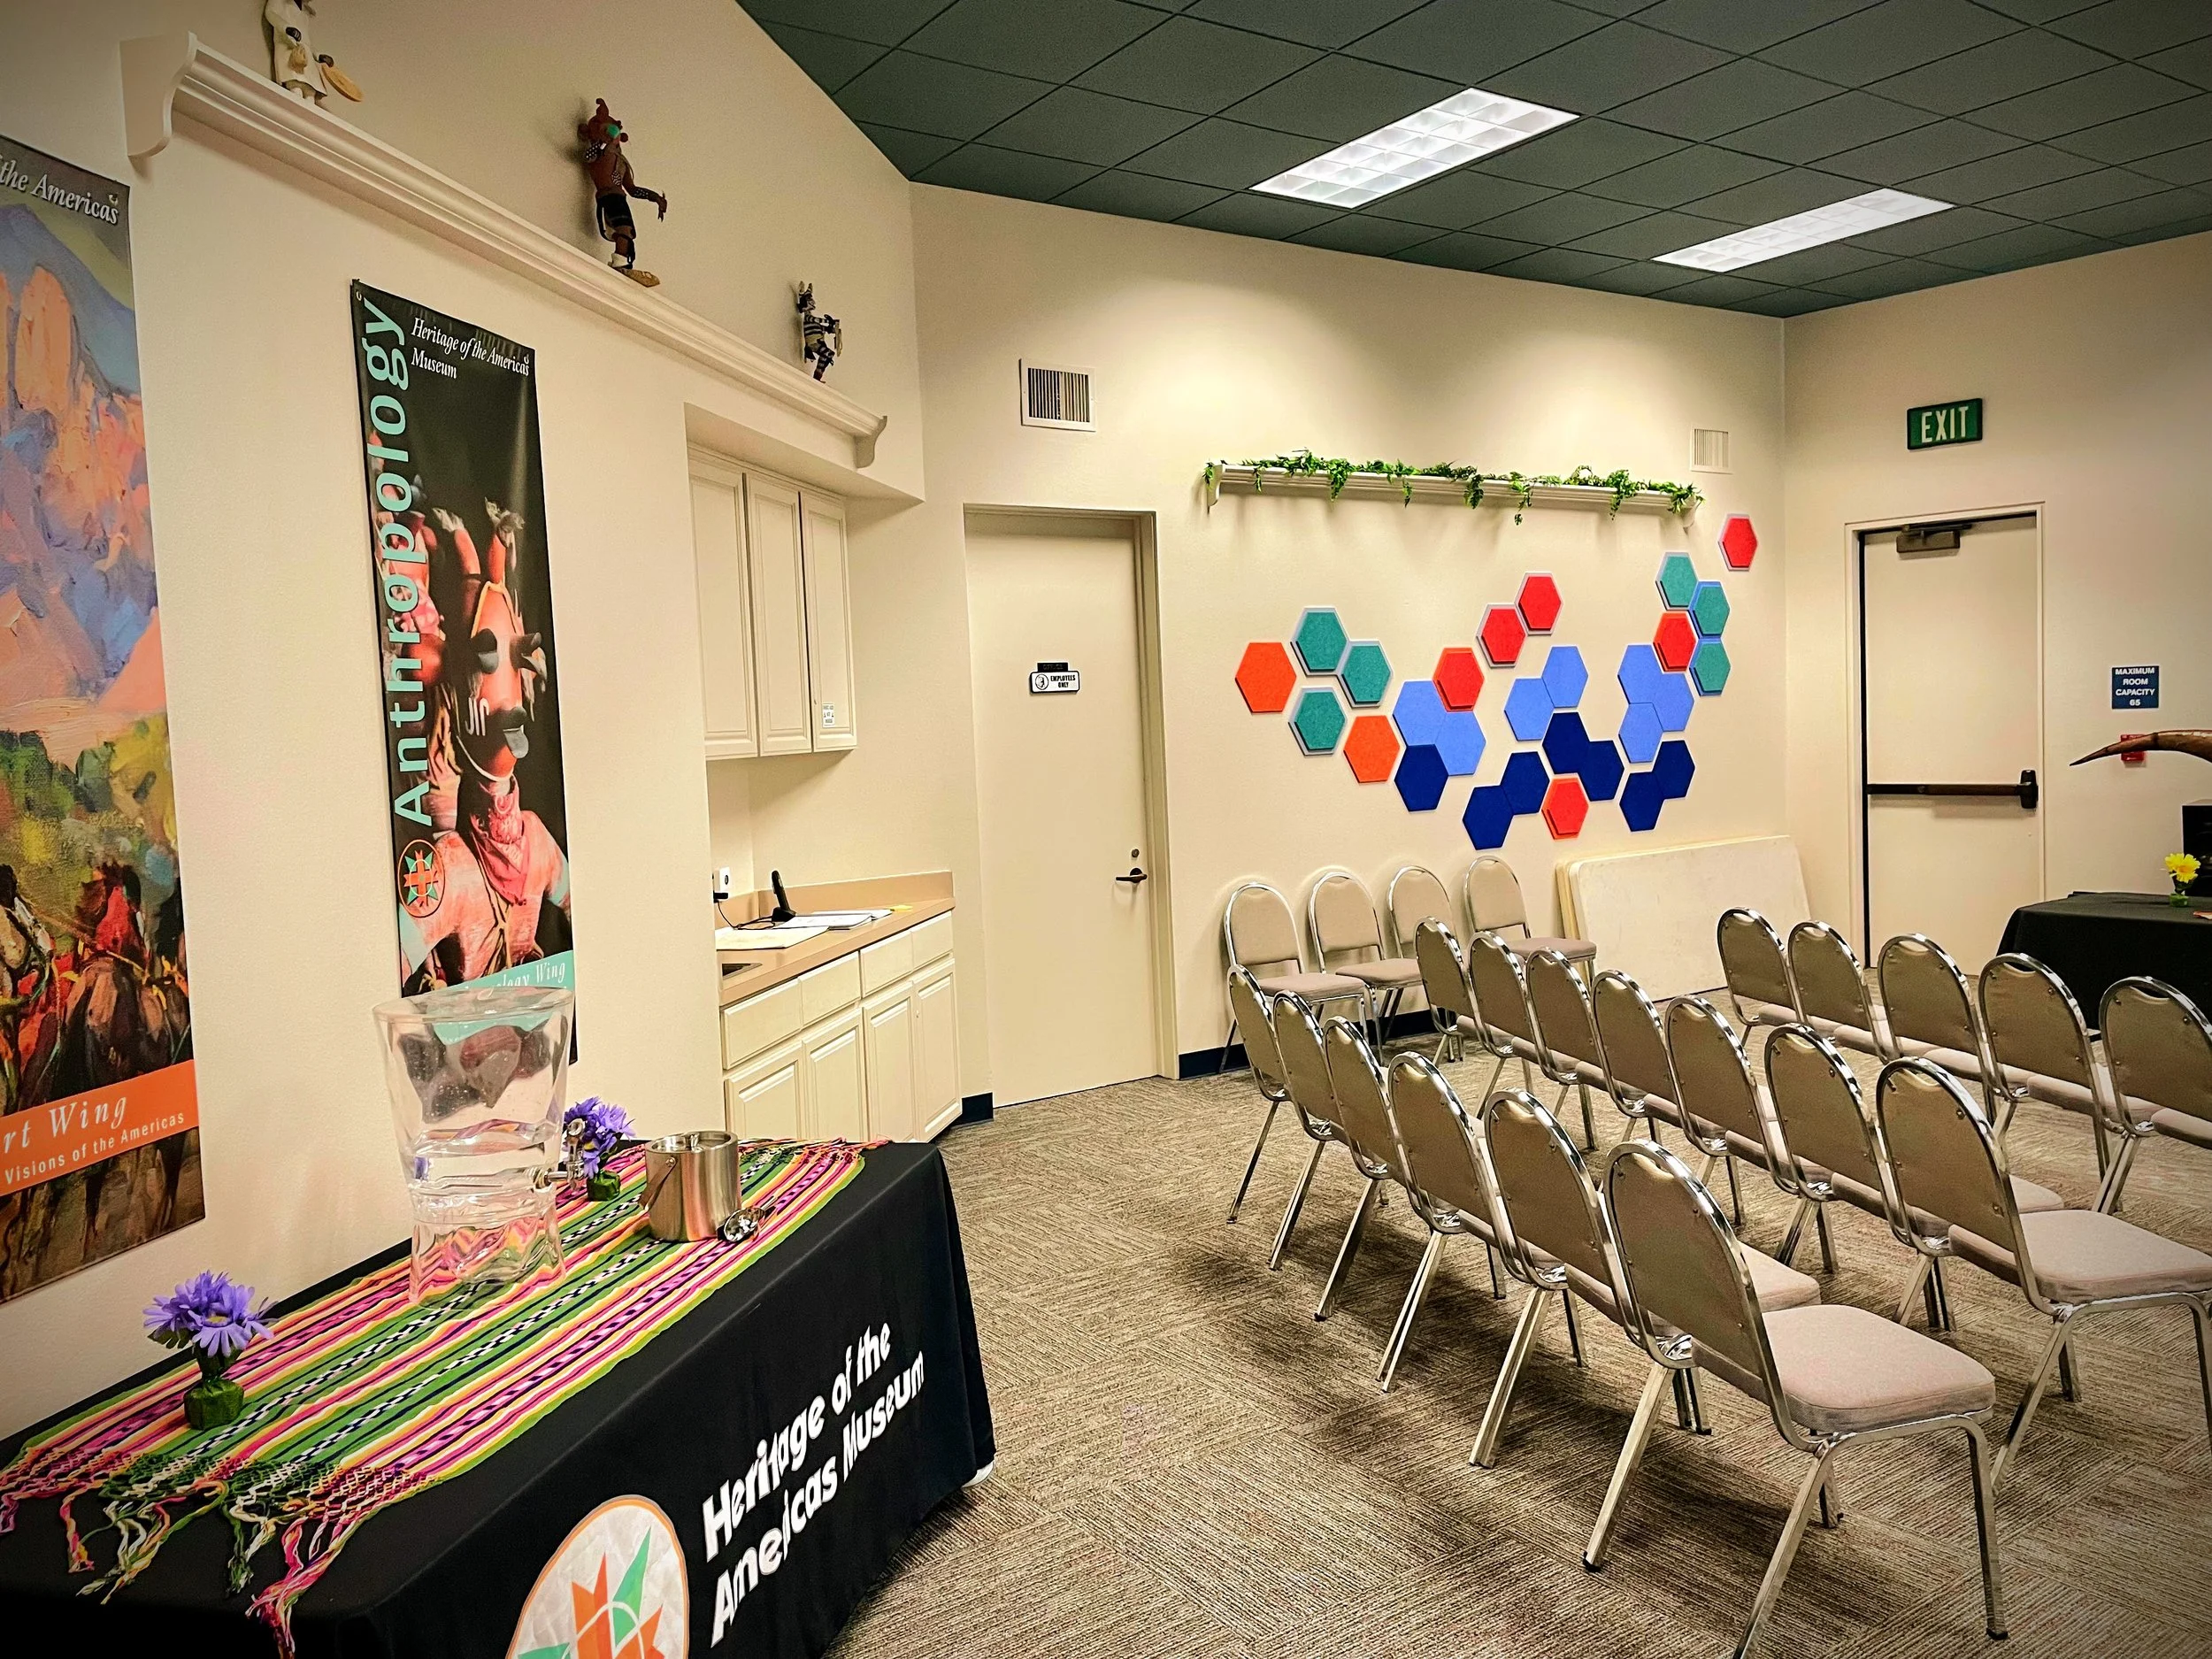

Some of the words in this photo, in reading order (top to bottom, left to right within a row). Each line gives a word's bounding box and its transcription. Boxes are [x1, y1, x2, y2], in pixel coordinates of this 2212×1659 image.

[0, 159, 28, 191] the
[30, 173, 119, 225] Americas
[411, 317, 458, 355] Heritage
[460, 337, 477, 360] of
[473, 339, 486, 361] the
[487, 349, 530, 376] Americas
[411, 348, 457, 379] Museum
[1921, 406, 1969, 443] EXIT
[361, 297, 433, 827] Anthropology
[536, 962, 565, 984] Wing
[3, 1119, 31, 1155] rt
[49, 1096, 127, 1139] Wing
[4, 1154, 65, 1185] Visions
[73, 1143, 88, 1163] of
[93, 1136, 115, 1155] the
[121, 1112, 185, 1143] Americas
[703, 1394, 826, 1563] Heritage
[832, 1345, 852, 1416] of
[857, 1322, 891, 1387] the
[710, 1455, 838, 1648] Ameicas
[843, 1350, 925, 1483] Museum
